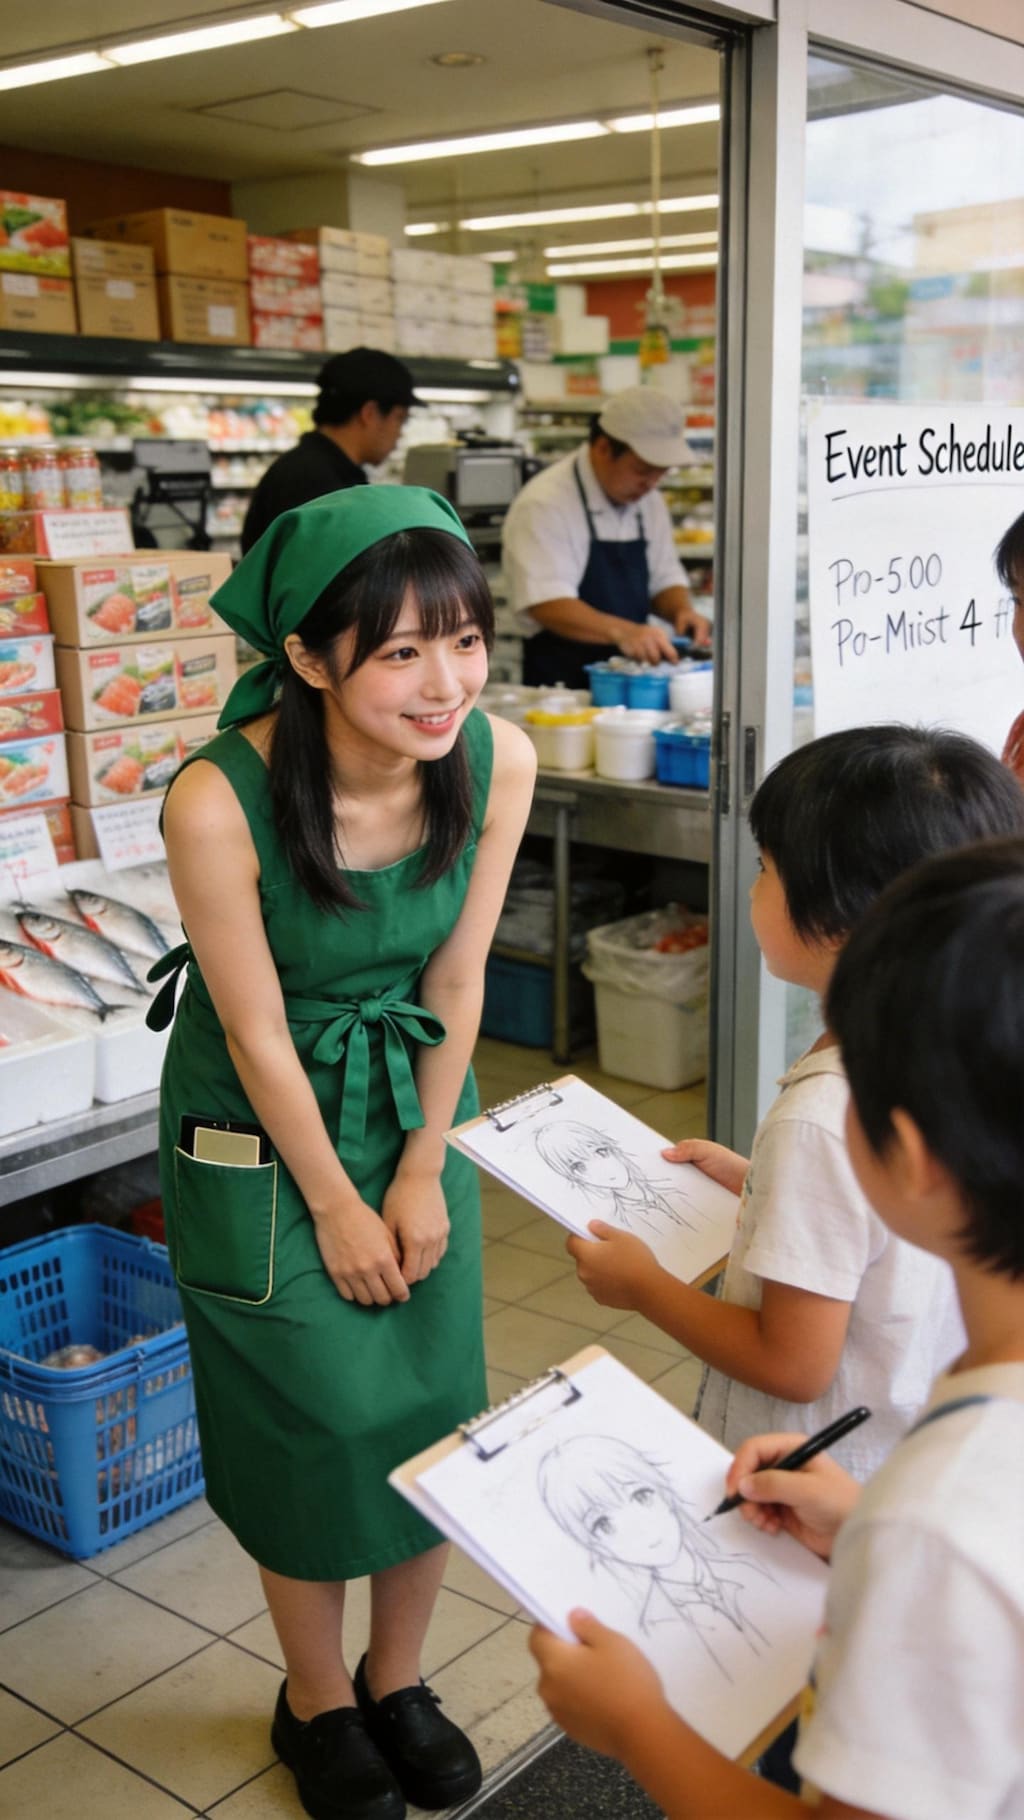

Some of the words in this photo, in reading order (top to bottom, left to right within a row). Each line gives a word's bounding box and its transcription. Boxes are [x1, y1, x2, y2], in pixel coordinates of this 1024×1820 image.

[825, 430, 907, 483] Event
[918, 423, 1024, 475] Schedule
[959, 598, 983, 646] 4
